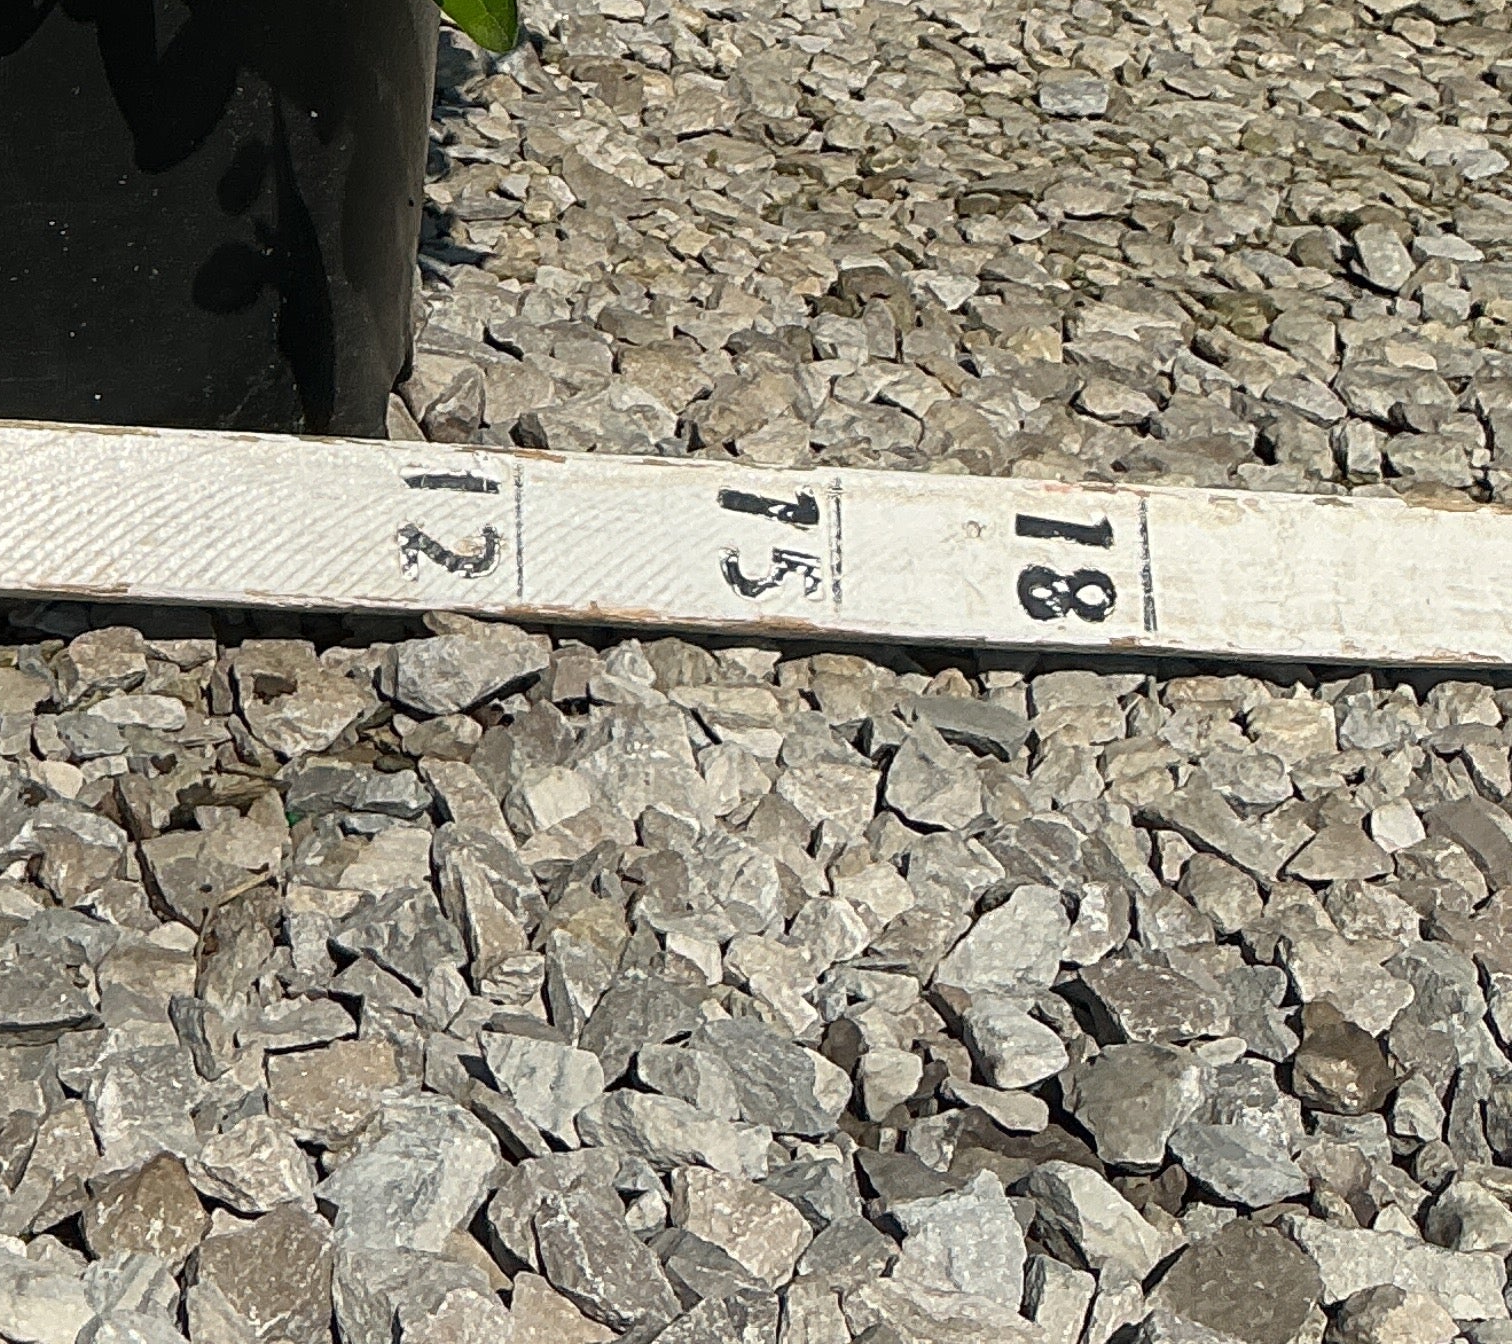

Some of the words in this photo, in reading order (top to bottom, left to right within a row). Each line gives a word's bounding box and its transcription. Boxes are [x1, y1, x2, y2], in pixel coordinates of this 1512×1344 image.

[397, 469, 502, 583] 12
[716, 484, 824, 602] 15
[1014, 511, 1118, 623] 18
